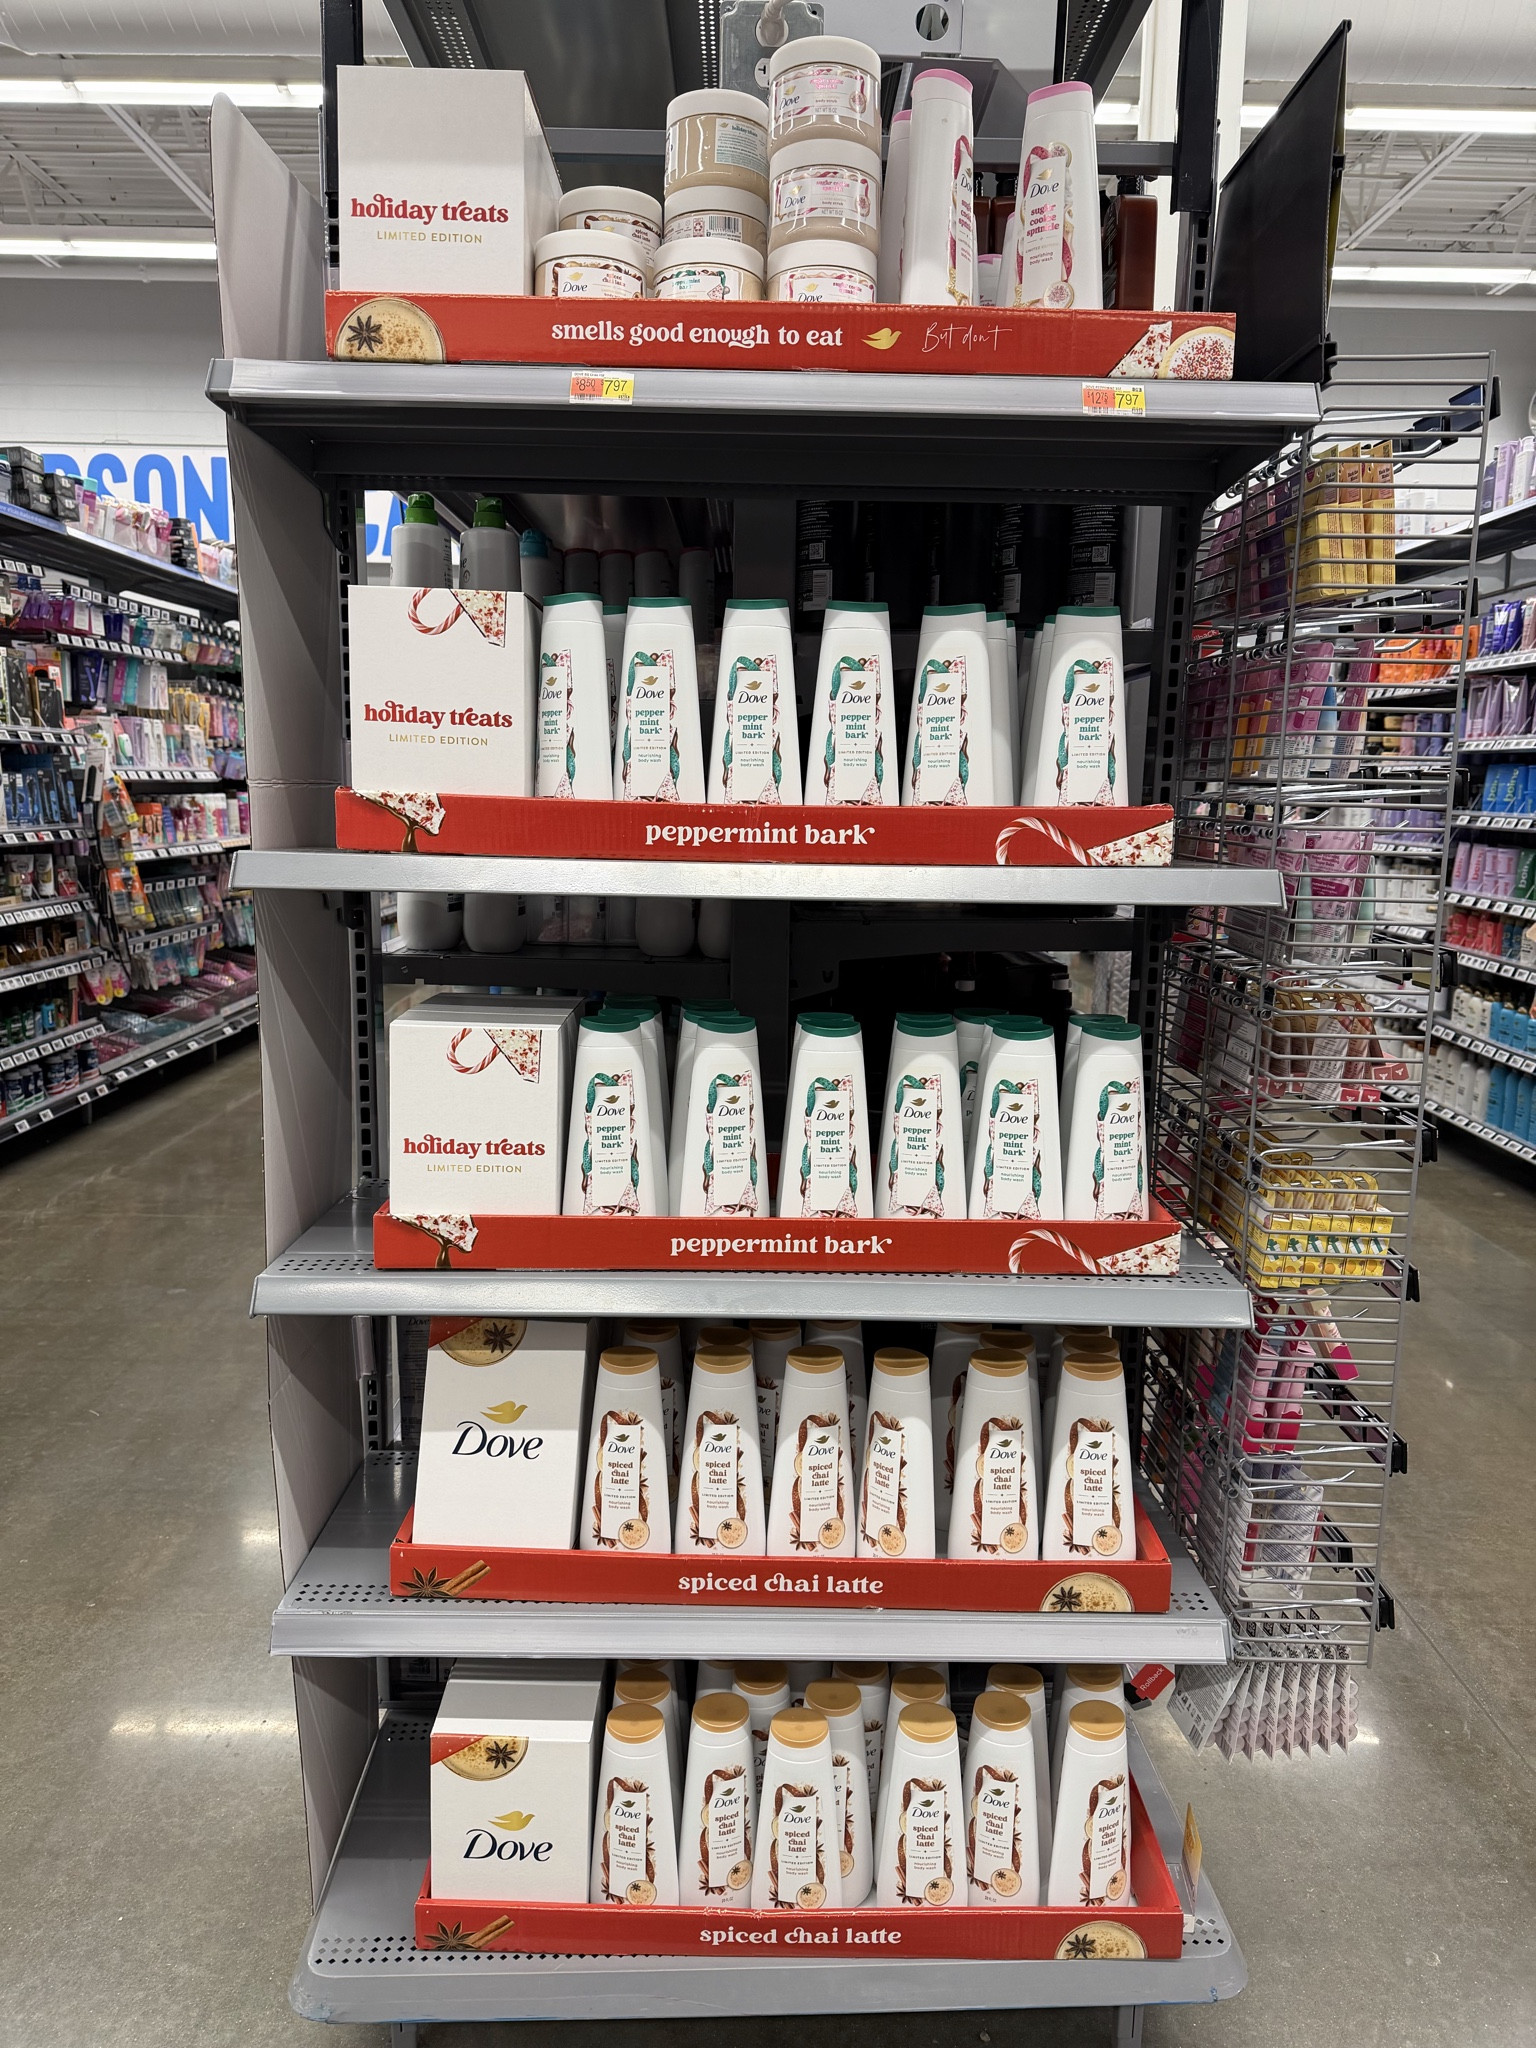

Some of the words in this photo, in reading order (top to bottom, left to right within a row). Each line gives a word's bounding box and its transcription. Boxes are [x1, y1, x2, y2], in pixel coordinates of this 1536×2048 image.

[1030, 182, 1060, 199] Dove
[784, 195, 806, 209] Dove
[350, 193, 438, 225] holiday
[442, 201, 508, 223] treats
[1031, 203, 1056, 216] sugar
[377, 231, 426, 241] LIMITED
[431, 233, 482, 243] EDITION
[562, 280, 588, 293] Dove
[797, 292, 822, 302] Dove
[551, 320, 624, 341] smells
[629, 323, 684, 347] good
[689, 324, 770, 348] enough
[778, 326, 800, 345] to
[806, 327, 843, 347] eat
[921, 321, 967, 353] But
[963, 324, 1013, 351] don't
[541, 687, 563, 700] Dove
[635, 686, 665, 699] Dove
[738, 690, 768, 704] Dove
[841, 690, 872, 704] Dove
[927, 693, 955, 706] Dove
[1075, 694, 1105, 706] Dove
[364, 700, 446, 729] holiday
[449, 707, 513, 728] treats
[737, 714, 768, 723] pepper
[840, 714, 871, 723] pepper
[639, 718, 659, 726] mint
[926, 715, 956, 725] pepper
[1074, 716, 1105, 725] pepper
[543, 727, 561, 735] bark
[639, 727, 662, 735] bark
[742, 722, 763, 731] mint
[845, 722, 866, 731] mint
[930, 724, 950, 732] mint
[1079, 724, 1100, 733] mint
[389, 733, 435, 744] LIMITED
[440, 735, 488, 746] EDITION
[742, 731, 766, 739] bark
[845, 731, 869, 739] bark
[929, 732, 953, 741] bark
[1078, 733, 1102, 741] bark
[645, 821, 798, 847] peppermint
[805, 824, 875, 845] bark
[596, 1104, 625, 1117] Dove
[718, 1105, 745, 1117] Dove
[816, 1109, 845, 1121] Dove
[903, 1106, 932, 1119] Dove
[999, 1111, 1029, 1124] Dove
[1109, 1112, 1135, 1125] Dove
[596, 1124, 626, 1134] pepper
[717, 1124, 746, 1134] pepper
[815, 1129, 845, 1138] pepper
[902, 1126, 932, 1136] pepper
[601, 1132, 621, 1141] mint
[723, 1132, 742, 1141] mint
[907, 1135, 927, 1143] mint
[999, 1131, 1029, 1140] pepper
[1109, 1131, 1135, 1140] pepper
[403, 1133, 482, 1159] holiday
[485, 1138, 546, 1156] treats
[601, 1140, 624, 1149] bark
[722, 1140, 744, 1149] bark
[820, 1137, 840, 1145] mint
[1003, 1140, 1023, 1148] mint
[1114, 1140, 1131, 1148] mint
[906, 1143, 930, 1151] bark
[1002, 1148, 1026, 1156] bark
[1113, 1148, 1133, 1156] bark
[427, 1164, 472, 1172] LIMITED
[476, 1164, 522, 1173] EDITION
[670, 1233, 818, 1257] peppermint
[824, 1235, 893, 1254] bark
[451, 1420, 544, 1460] Dove
[607, 1441, 635, 1454] Dove
[704, 1441, 732, 1454] Dove
[807, 1445, 835, 1457] Dove
[873, 1442, 896, 1459] Dove
[989, 1448, 1017, 1460] Dove
[1079, 1448, 1108, 1461] Dove
[607, 1461, 634, 1470] spiced
[705, 1461, 731, 1469] spiced
[808, 1463, 833, 1471] spiced
[873, 1461, 894, 1474] spiced
[611, 1469, 629, 1477] chai
[709, 1469, 727, 1477] chai
[812, 1471, 829, 1479] chai
[875, 1469, 890, 1481] chai
[990, 1467, 1015, 1476] spiced
[1080, 1468, 1106, 1477] spiced
[611, 1477, 629, 1485] latte
[811, 1479, 830, 1487] latte
[874, 1478, 890, 1489] latte
[993, 1475, 1012, 1483] chai
[1084, 1476, 1103, 1484] chai
[993, 1482, 1012, 1490] latte
[1084, 1484, 1103, 1492] latte
[678, 1572, 757, 1594] spiced
[764, 1573, 819, 1592] chai
[827, 1575, 884, 1593] latte
[1139, 1667, 1164, 1692] Rollback
[714, 1796, 741, 1808] Dove
[982, 1792, 1010, 1808] Dove
[614, 1805, 641, 1820] Dove
[714, 1811, 739, 1822] spiced
[911, 1806, 940, 1818] Dove
[1098, 1804, 1121, 1819] Dove
[783, 1811, 812, 1824] Dove
[982, 1811, 1008, 1823] spiced
[614, 1823, 640, 1833] spiced
[718, 1821, 736, 1829] chai
[912, 1825, 938, 1833] spiced
[985, 1820, 1004, 1830] chai
[1098, 1820, 1120, 1833] spiced
[618, 1832, 636, 1840] chai
[718, 1828, 736, 1837] latte
[784, 1830, 810, 1839] spiced
[916, 1832, 935, 1840] chai
[985, 1827, 1004, 1837] latte
[1101, 1829, 1117, 1840] chai
[463, 1828, 553, 1862] Dove
[618, 1840, 636, 1848] latte
[1101, 1837, 1117, 1847] latte
[788, 1845, 807, 1853] latte
[699, 1926, 777, 1945] spiced
[784, 1926, 839, 1944] chai
[845, 1927, 902, 1944] latte
